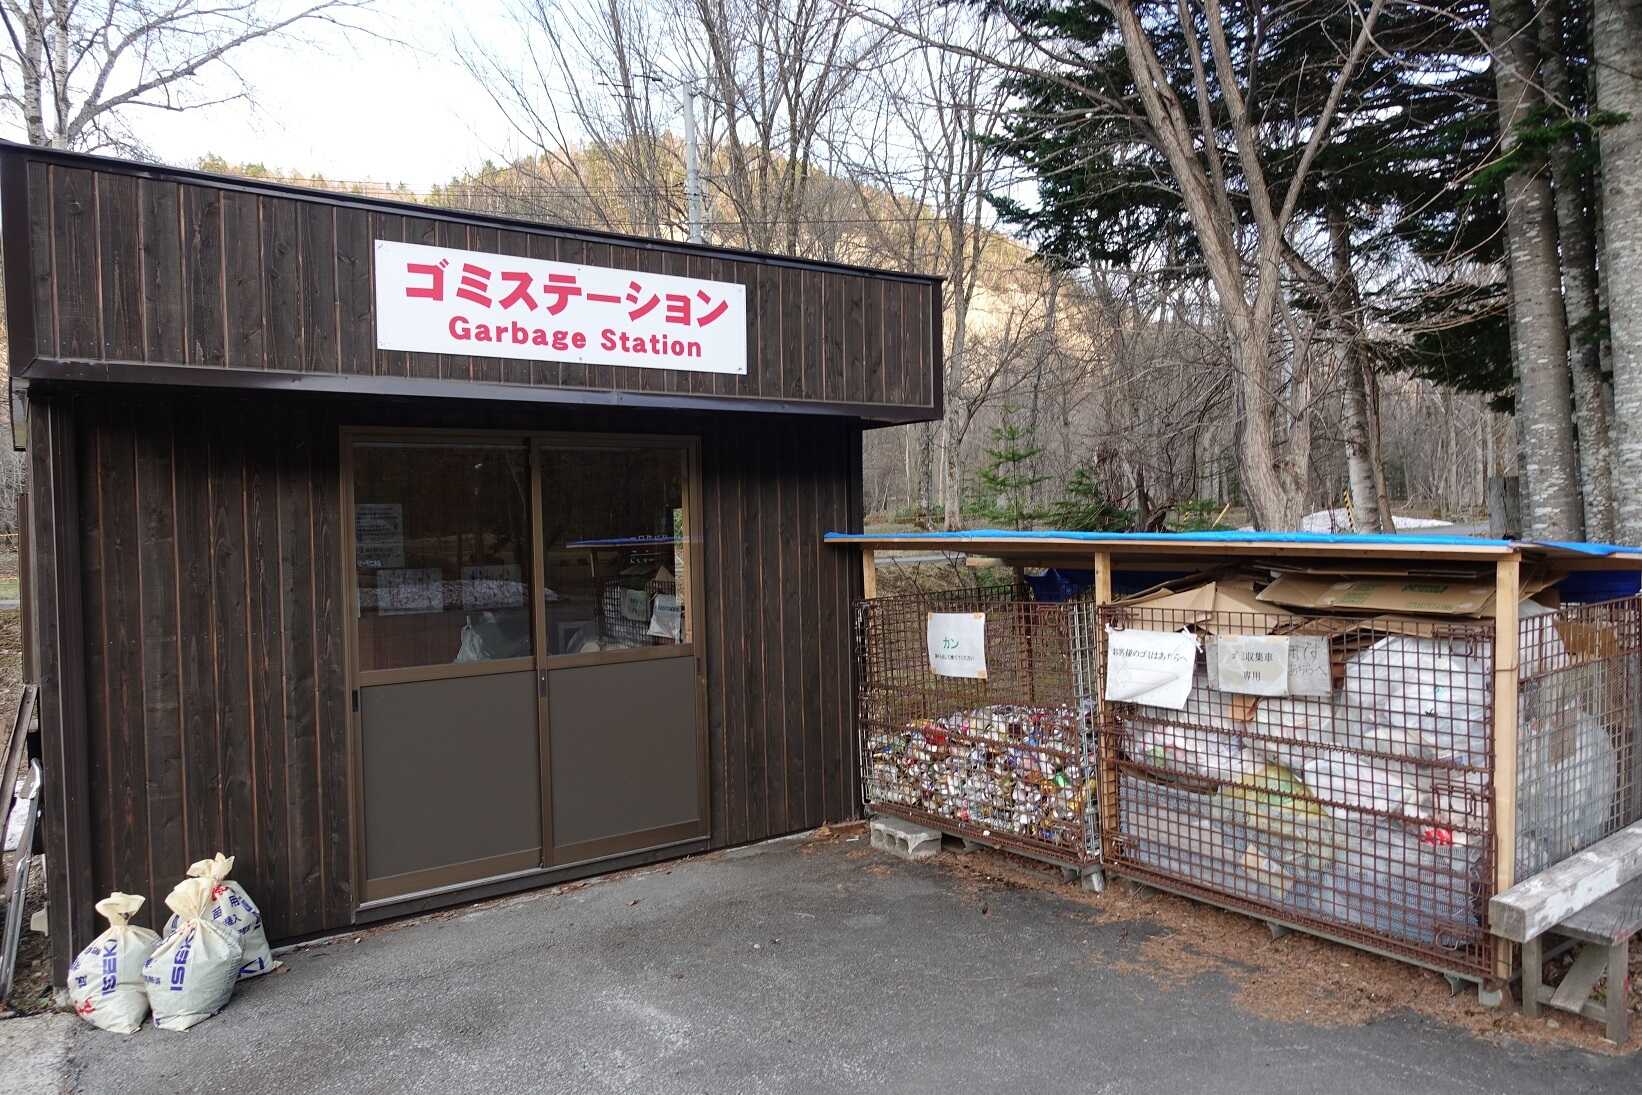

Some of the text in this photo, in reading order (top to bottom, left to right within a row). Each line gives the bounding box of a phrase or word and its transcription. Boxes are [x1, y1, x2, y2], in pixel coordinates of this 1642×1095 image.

[405, 258, 729, 328] ゴミステーション
[449, 315, 702, 358] Garbage Station
[942, 636, 960, 650] カン
[169, 927, 197, 991] ISEK
